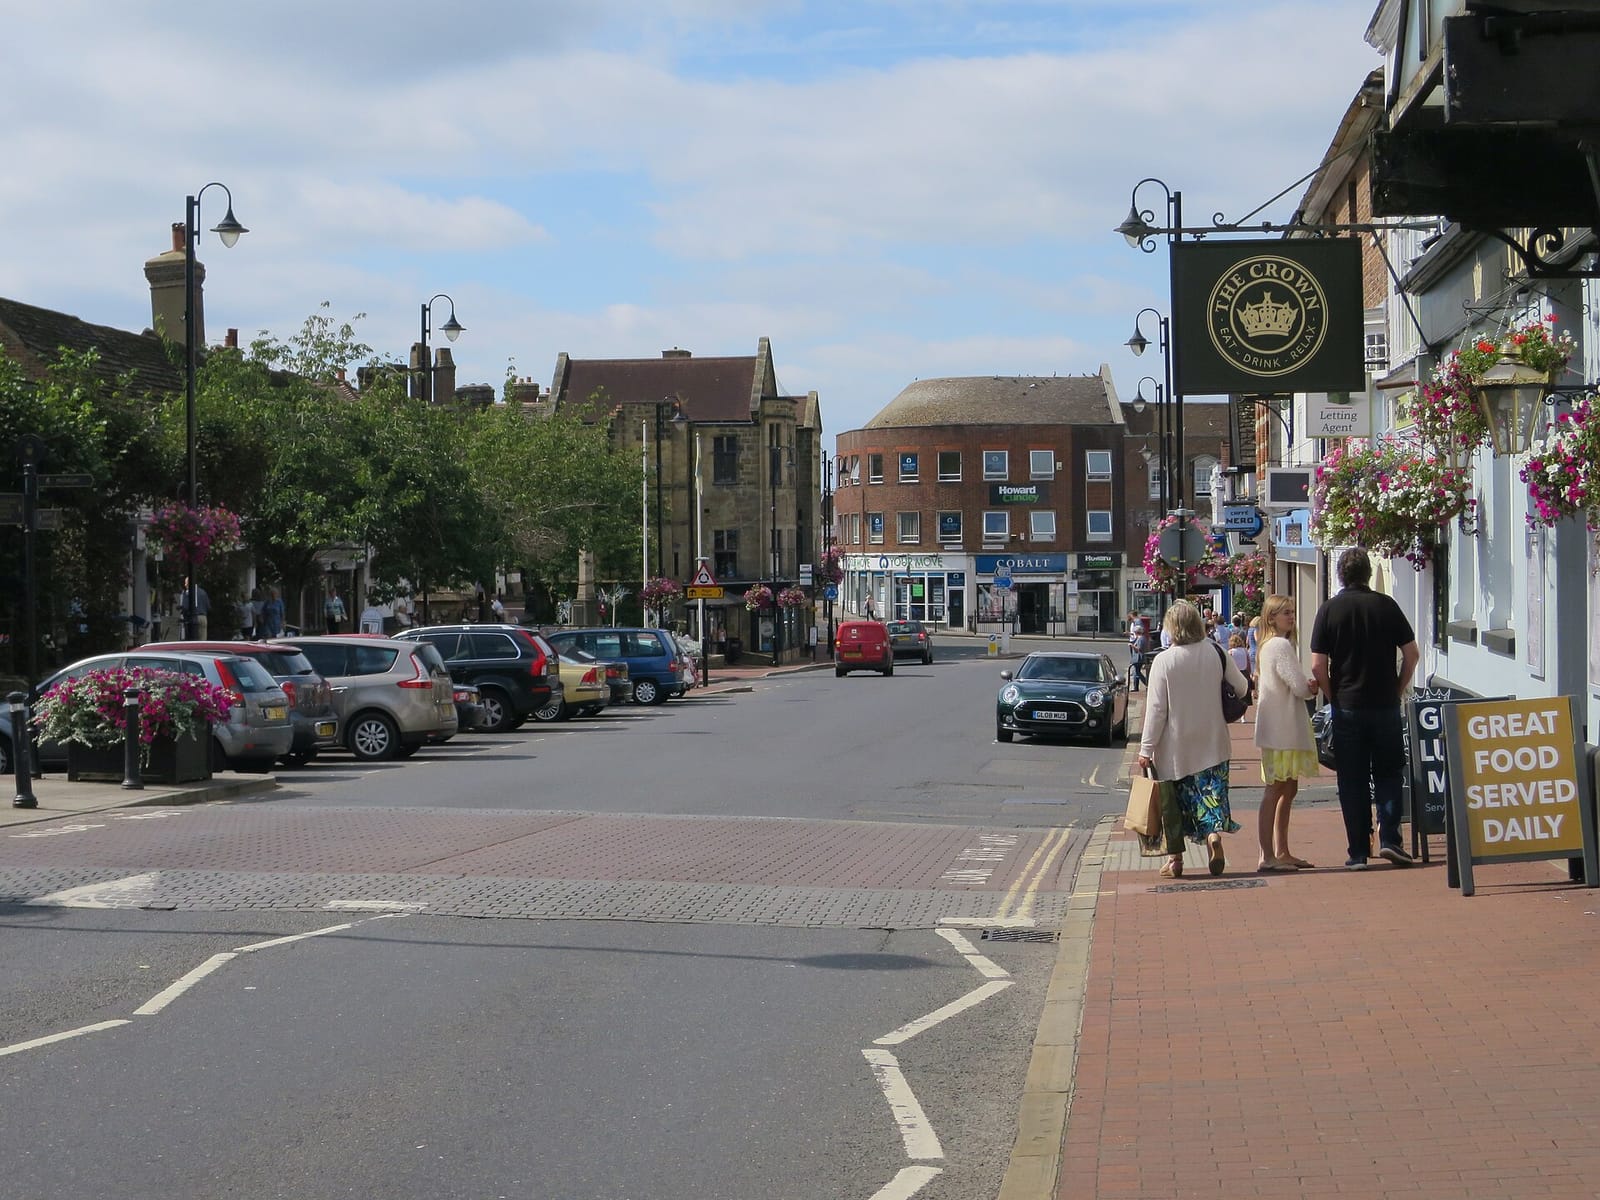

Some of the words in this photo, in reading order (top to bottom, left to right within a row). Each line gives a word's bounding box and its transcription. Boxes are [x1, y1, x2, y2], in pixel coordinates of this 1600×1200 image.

[1215, 273, 1246, 313] THE
[1249, 262, 1320, 310] CROWN
[1220, 327, 1238, 349] EAT
[1243, 353, 1281, 368] DRINK
[1290, 325, 1317, 360] RELAX
[1320, 410, 1358, 422] Letting
[1321, 423, 1353, 434] Agent
[998, 485, 1037, 495] Howard
[890, 556, 914, 567] YOUR
[914, 556, 944, 568] MOVE
[996, 559, 1050, 568] COBALT
[1419, 706, 1444, 730] G
[1467, 711, 1558, 740] GREAT
[1420, 738, 1445, 762] LU
[1474, 746, 1559, 774] FOOD
[1427, 770, 1446, 793] M
[1466, 779, 1576, 810] SERVED
[1424, 802, 1445, 812] Serv
[1482, 814, 1564, 843] DAILY
